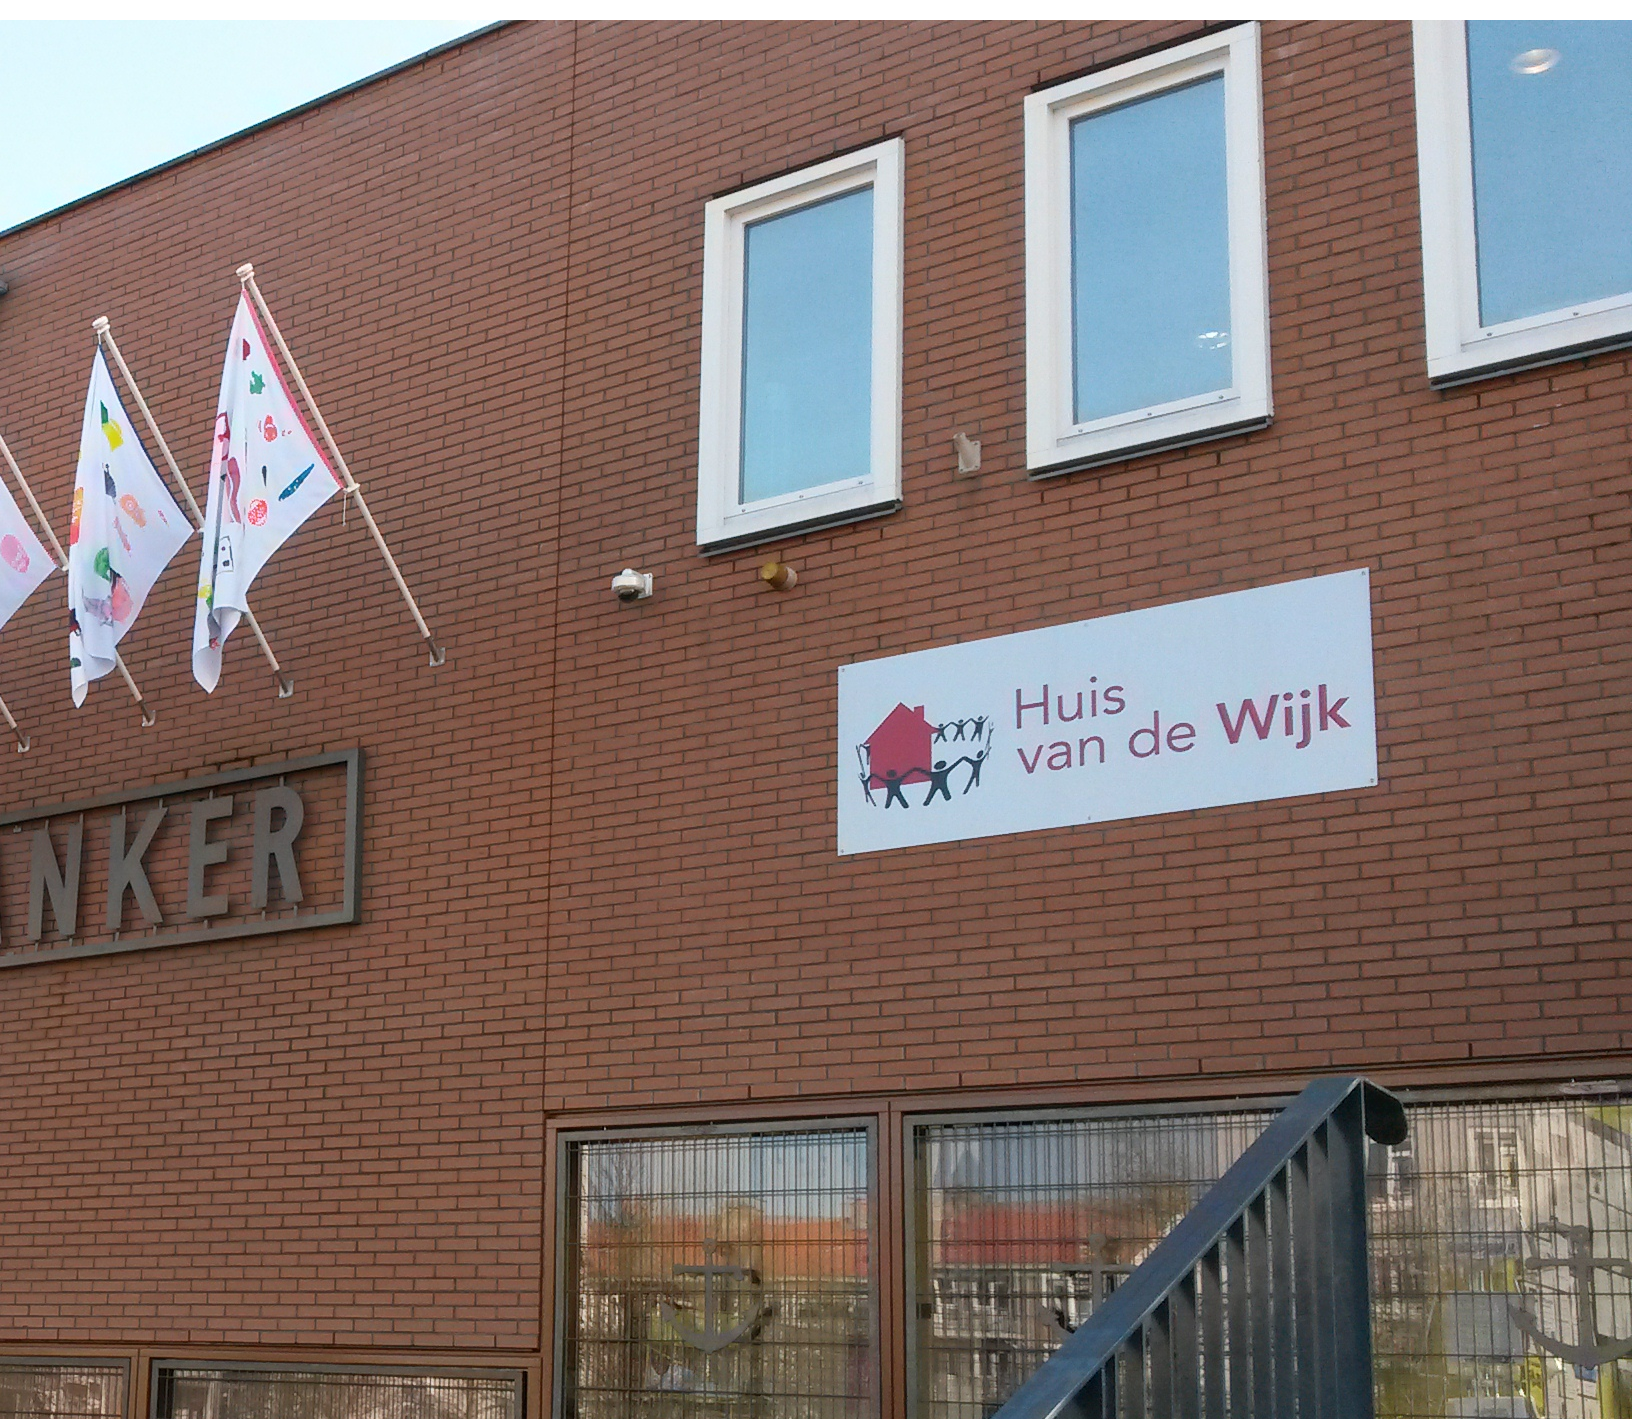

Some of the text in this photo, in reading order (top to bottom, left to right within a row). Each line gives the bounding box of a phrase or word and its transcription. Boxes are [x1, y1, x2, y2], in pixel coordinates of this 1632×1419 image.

[1014, 675, 1126, 729] Huis
[1017, 684, 1352, 774] van de Wijk
